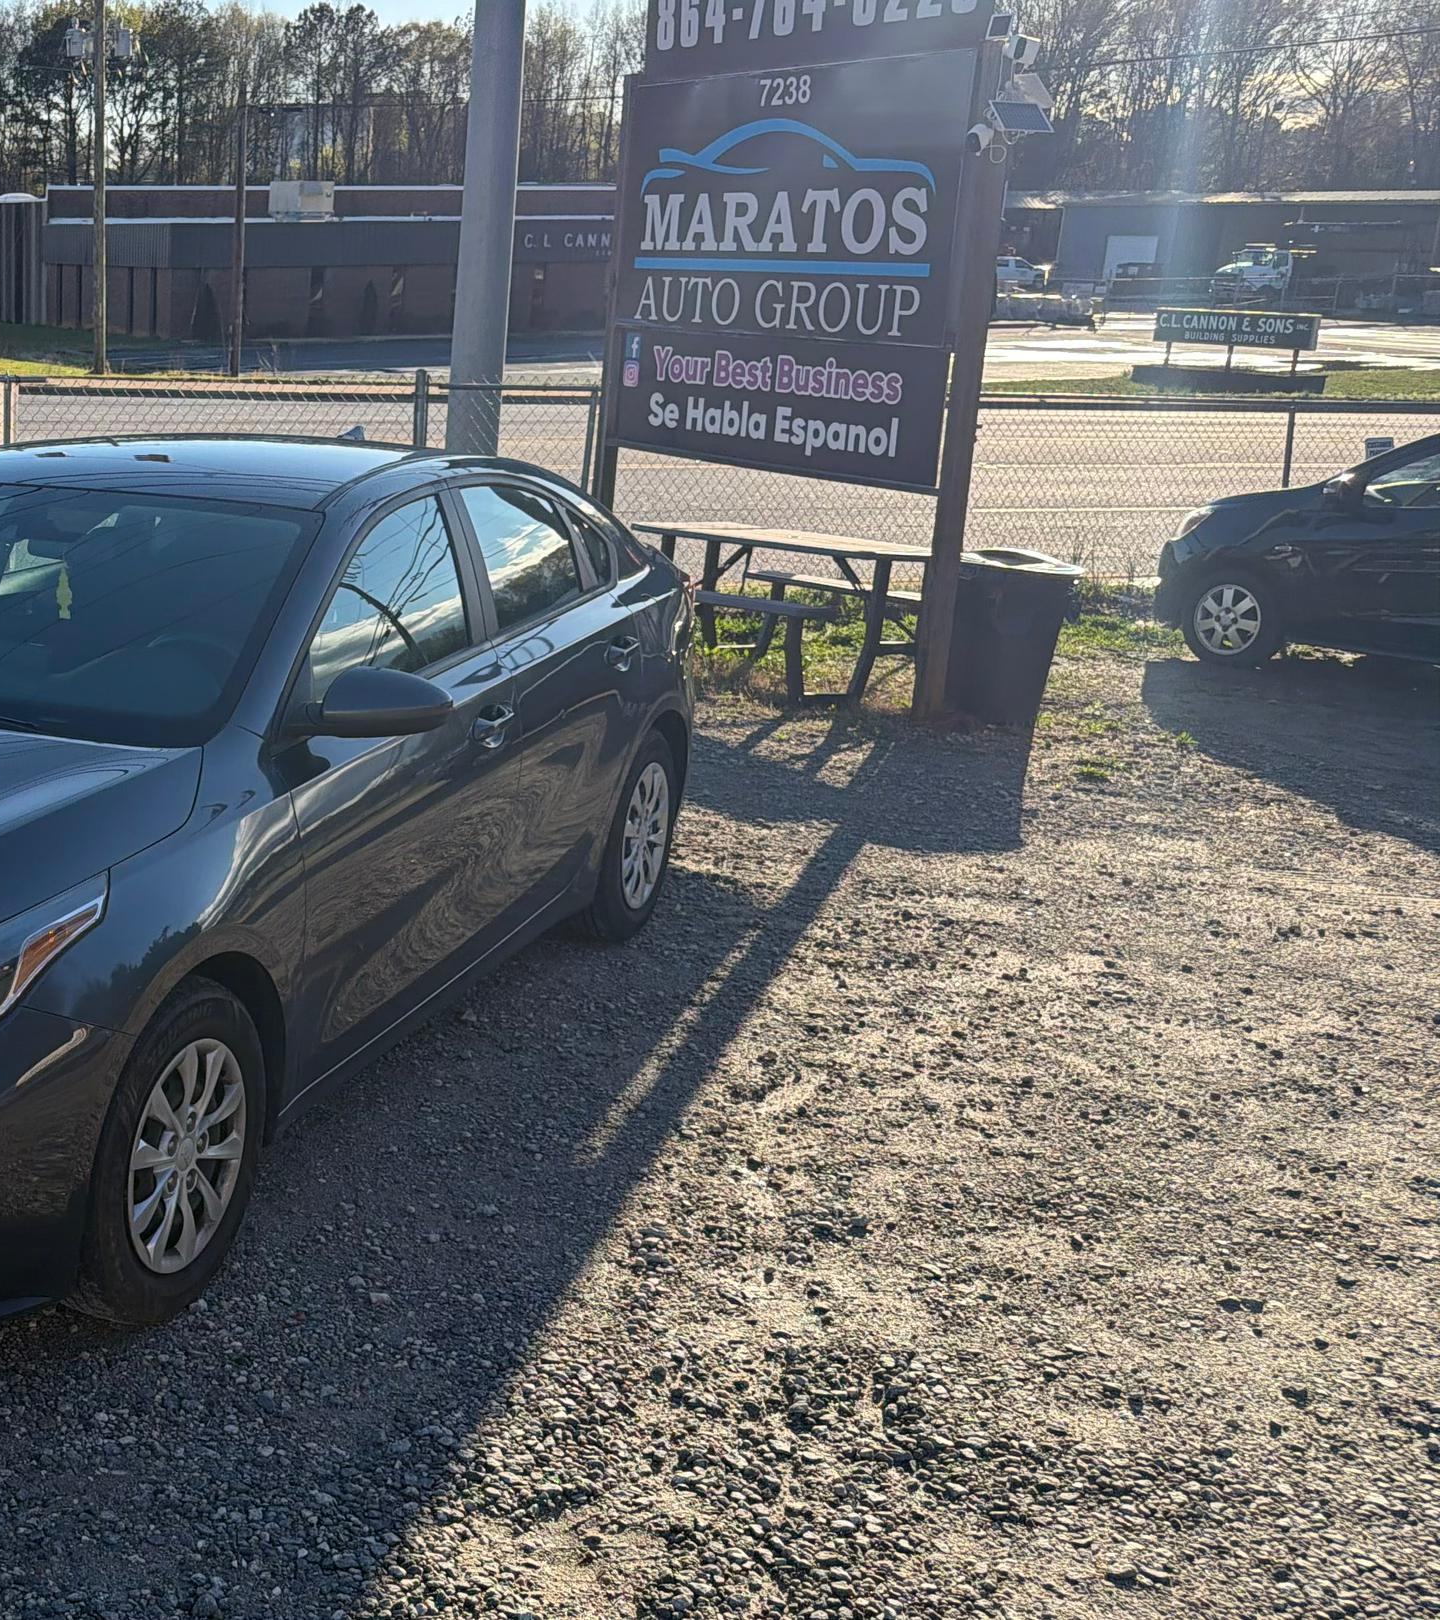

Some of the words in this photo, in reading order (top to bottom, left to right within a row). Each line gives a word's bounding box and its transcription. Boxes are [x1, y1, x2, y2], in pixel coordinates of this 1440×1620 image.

[760, 75, 811, 106] 7238
[640, 187, 928, 256] MARATOS
[634, 276, 740, 325] AUTO
[754, 279, 920, 336] GROUP
[1182, 315, 1237, 331] CANNON
[1242, 317, 1251, 332] &
[1257, 318, 1295, 334] SONS
[1184, 331, 1225, 341] BUILDING
[1231, 333, 1276, 345] SUPPLIES
[653, 345, 711, 385] Your
[713, 350, 773, 392] Best
[775, 354, 903, 405] Business
[647, 391, 680, 429] Se
[685, 396, 767, 441] Habla
[773, 405, 899, 458] Espanol
